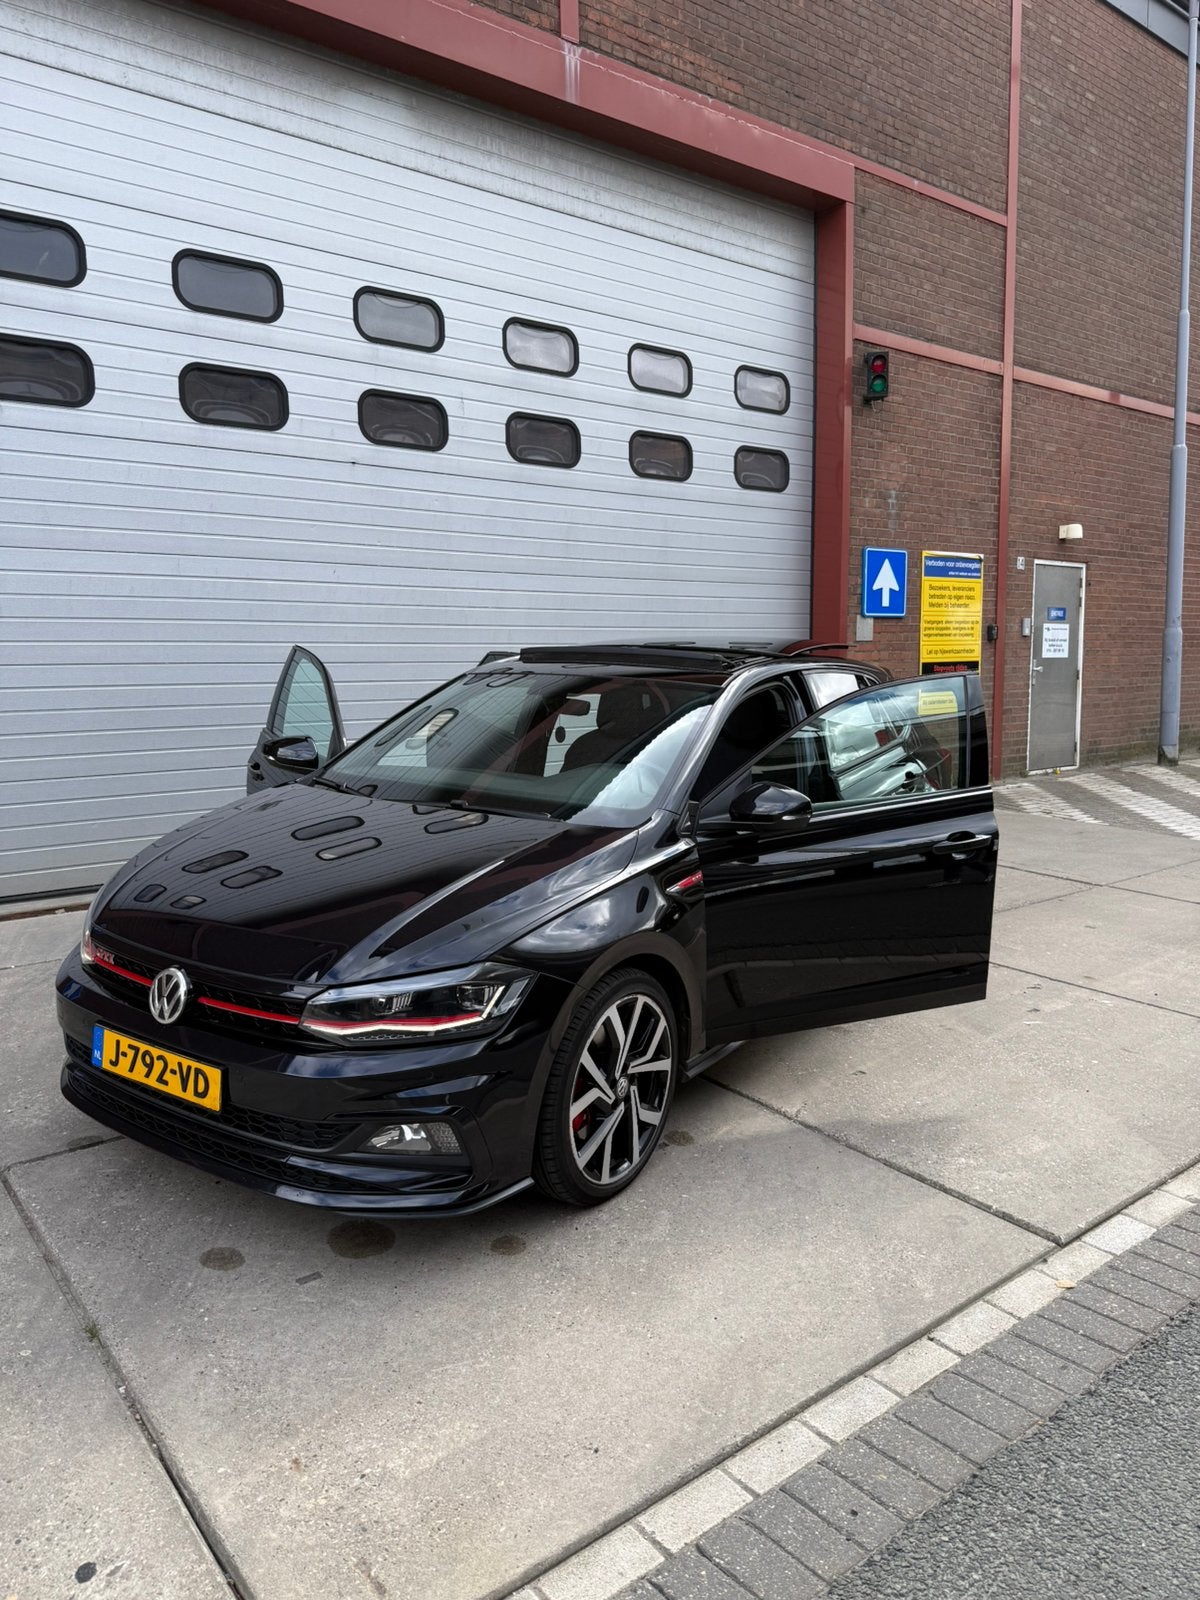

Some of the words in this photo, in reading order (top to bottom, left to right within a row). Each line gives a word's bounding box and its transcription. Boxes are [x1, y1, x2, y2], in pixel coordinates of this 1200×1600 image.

[925, 559, 946, 567] Verboden
[93, 1049, 102, 1061] NL
[109, 1039, 210, 1099] J-792-VD
